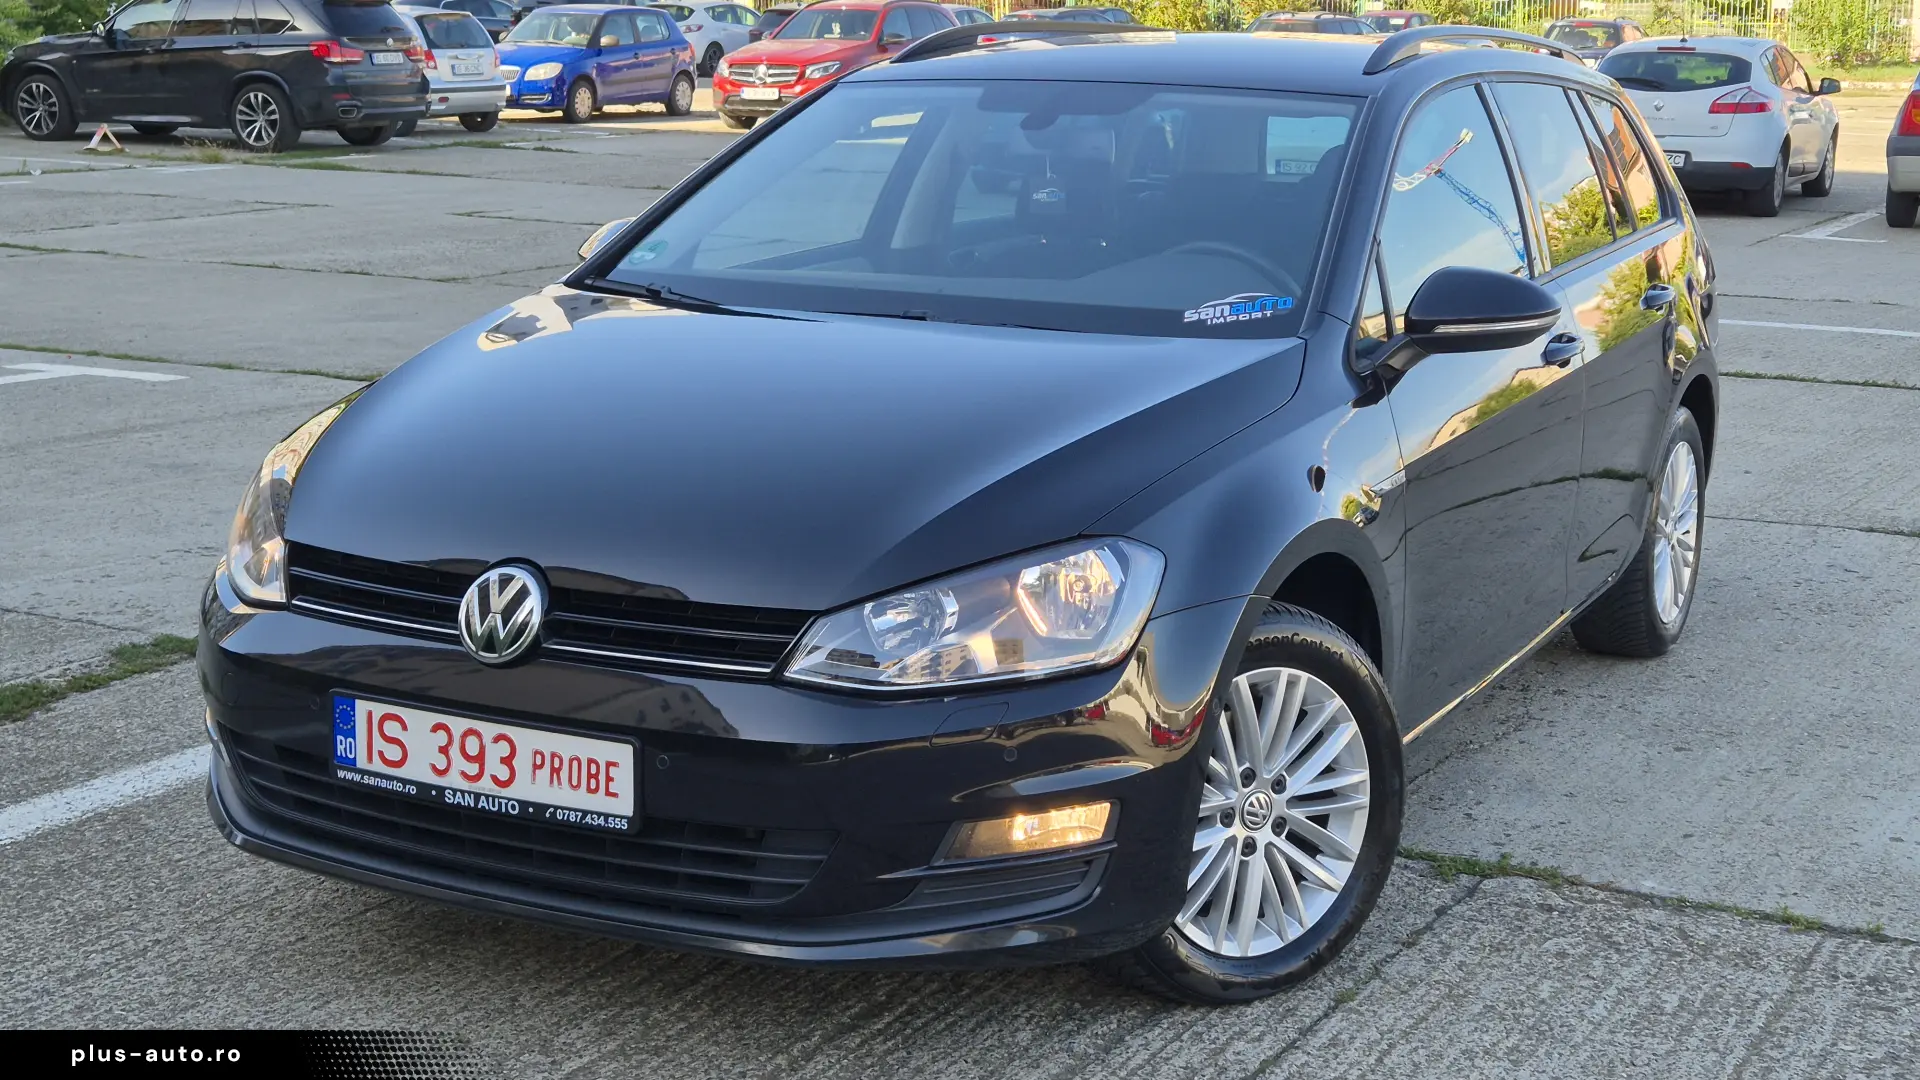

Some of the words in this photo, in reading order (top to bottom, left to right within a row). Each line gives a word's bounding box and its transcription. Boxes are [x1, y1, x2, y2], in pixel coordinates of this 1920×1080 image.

[1207, 311, 1274, 325] IMPORT
[336, 735, 355, 759] RO
[365, 708, 409, 769] IS
[429, 721, 518, 789] 393
[531, 747, 621, 799] PROBE
[337, 769, 417, 795] www.sanauto.ro
[444, 789, 475, 808] SAN
[478, 795, 520, 815] AUTO
[556, 808, 629, 830] 0787.434.555
